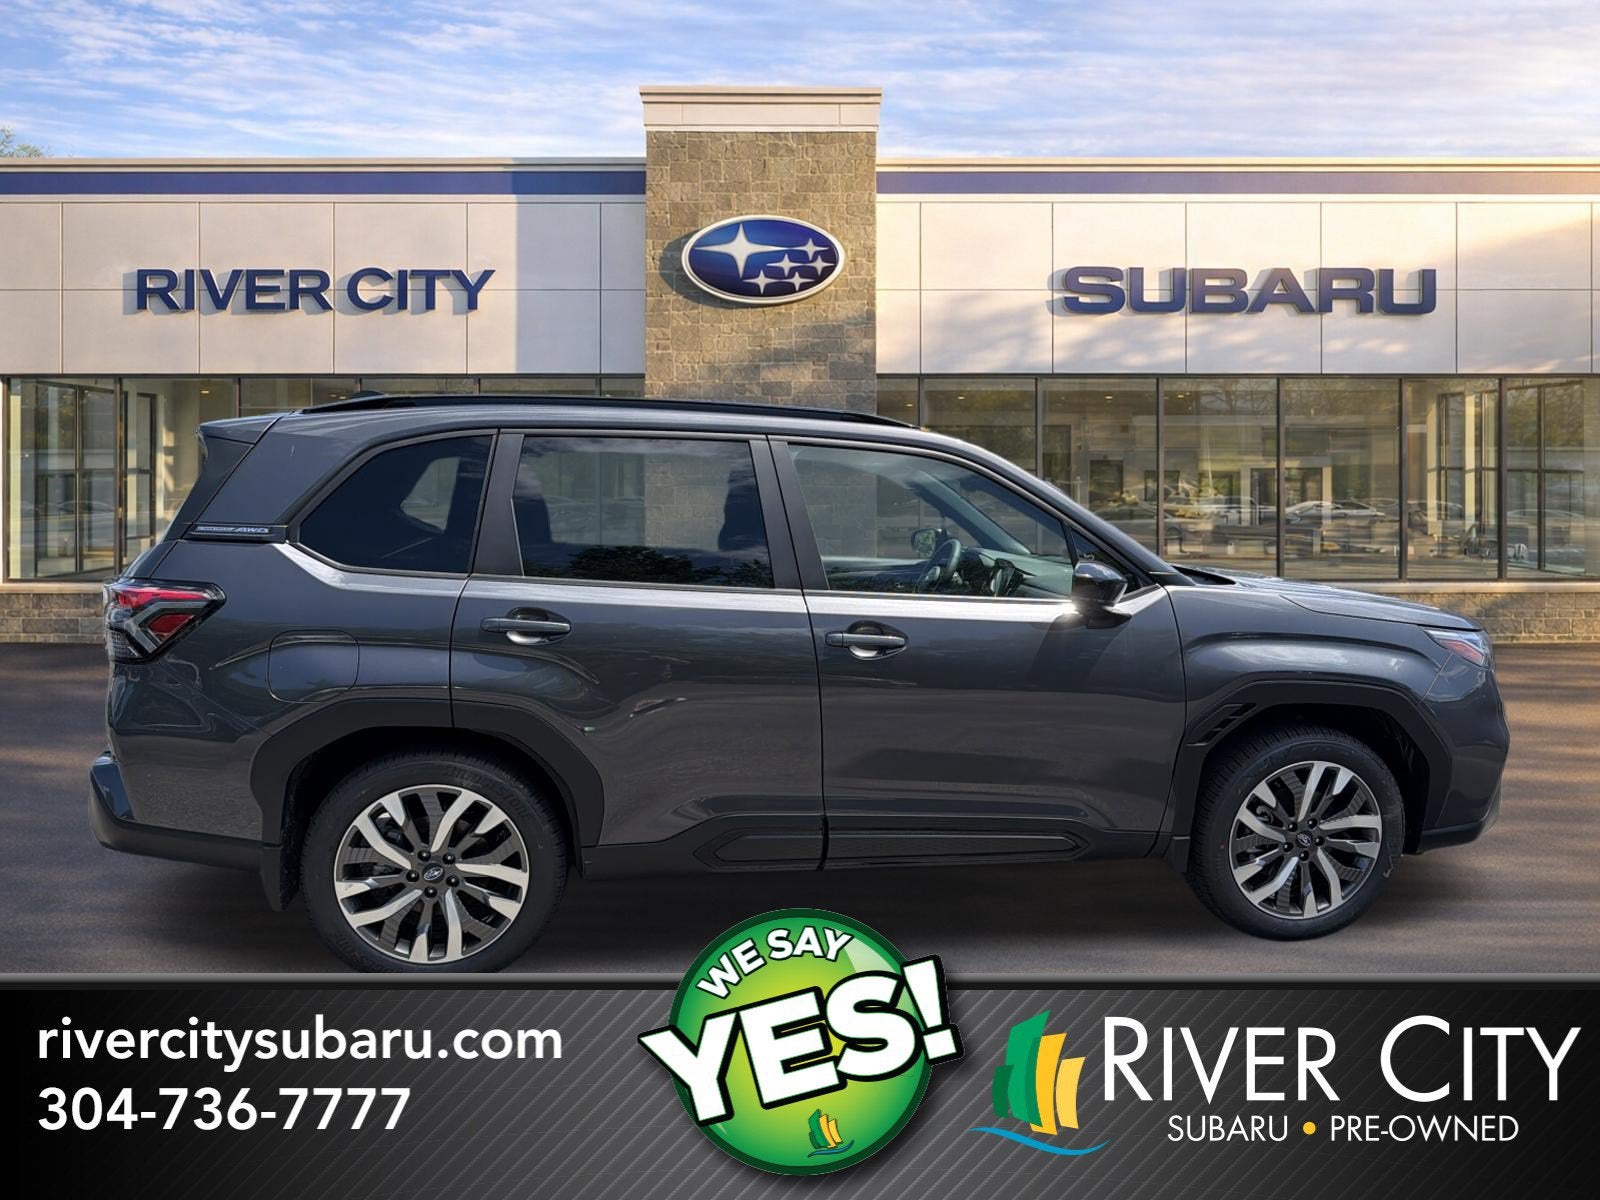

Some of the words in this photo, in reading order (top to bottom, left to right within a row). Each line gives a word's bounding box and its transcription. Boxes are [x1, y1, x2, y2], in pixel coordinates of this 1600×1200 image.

[136, 267, 335, 313] RIVER
[346, 266, 496, 313] CITY
[1063, 265, 1438, 315] SUBARU
